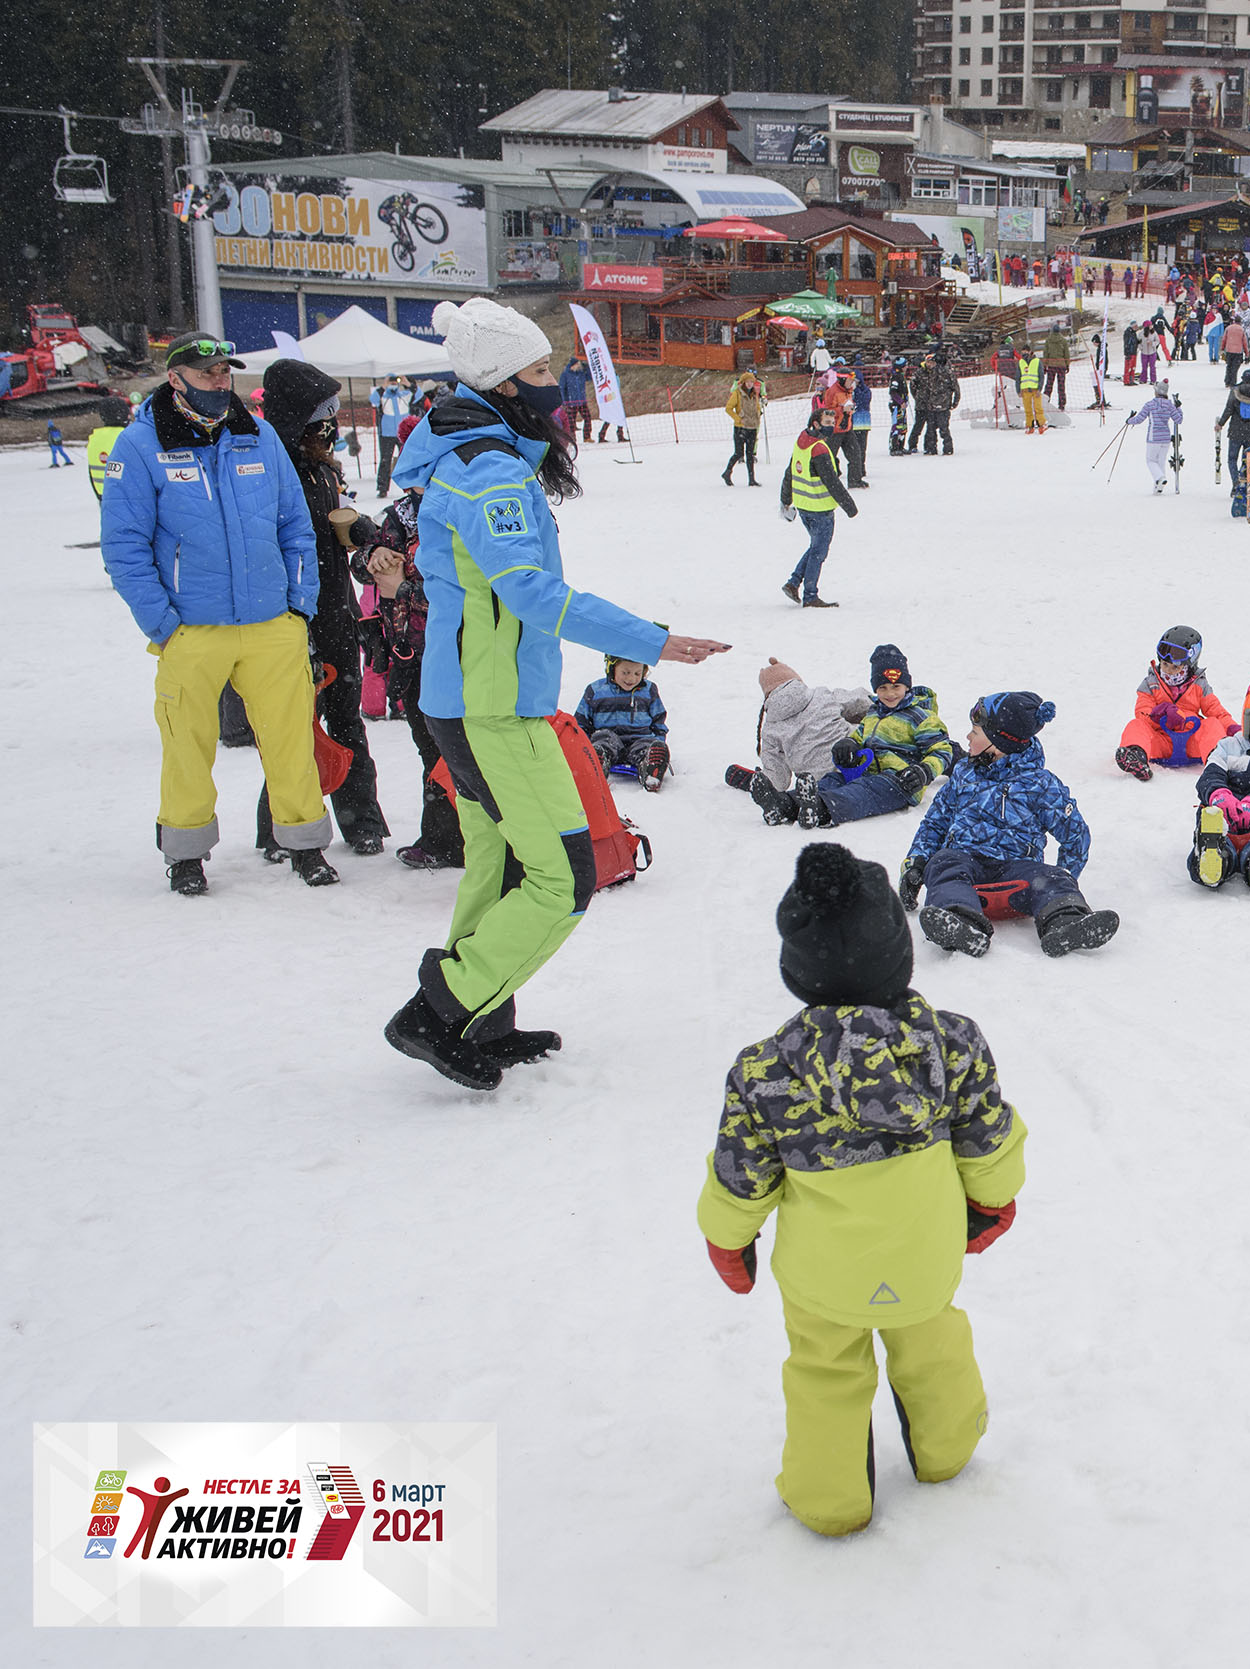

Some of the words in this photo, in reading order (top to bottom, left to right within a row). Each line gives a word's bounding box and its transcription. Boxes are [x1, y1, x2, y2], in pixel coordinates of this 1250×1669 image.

[756, 124, 795, 132] NEPTUN
[271, 192, 371, 236] НОВИ
[273, 240, 390, 274] АКТИВНОСТИ
[604, 274, 649, 286] ATOMIC
[496, 521, 522, 533] #v3
